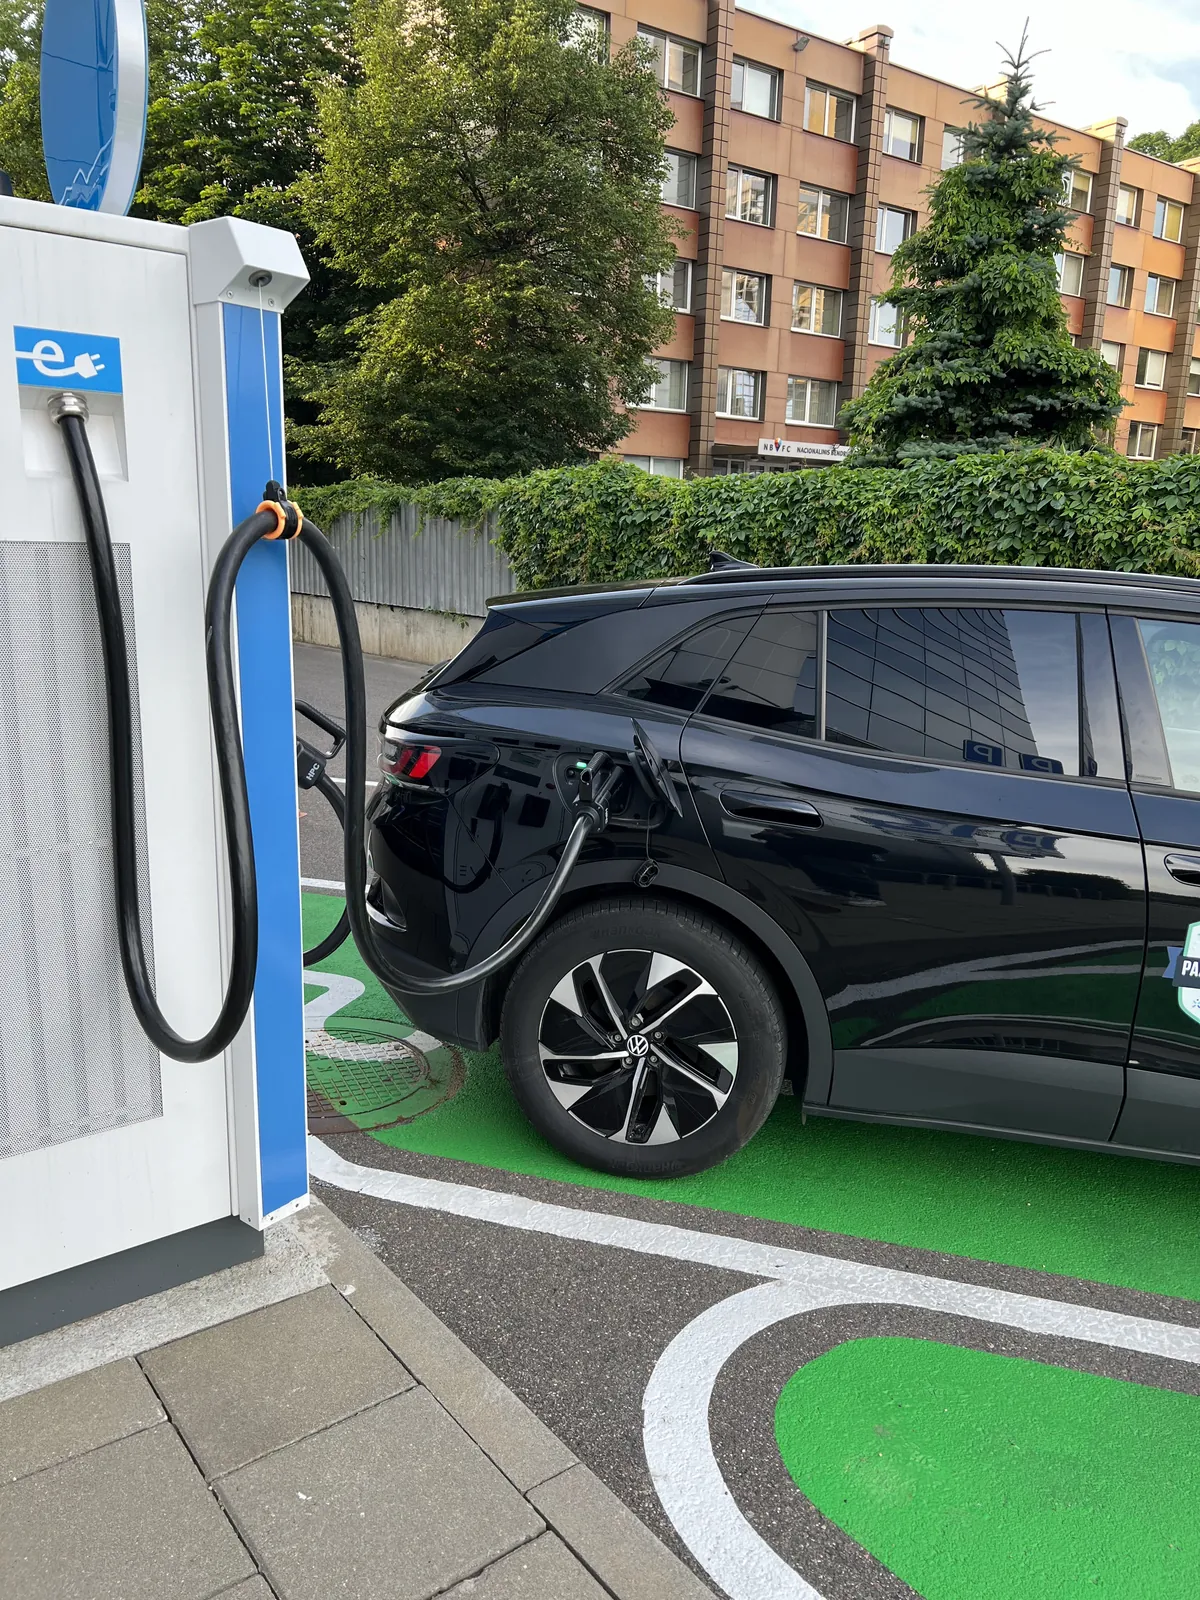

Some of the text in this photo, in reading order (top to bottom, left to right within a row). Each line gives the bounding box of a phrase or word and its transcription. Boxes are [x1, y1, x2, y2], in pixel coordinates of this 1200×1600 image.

[796, 446, 831, 456] NACIONALINIS
[305, 762, 320, 781] HPC
[1181, 959, 1200, 978] PA
